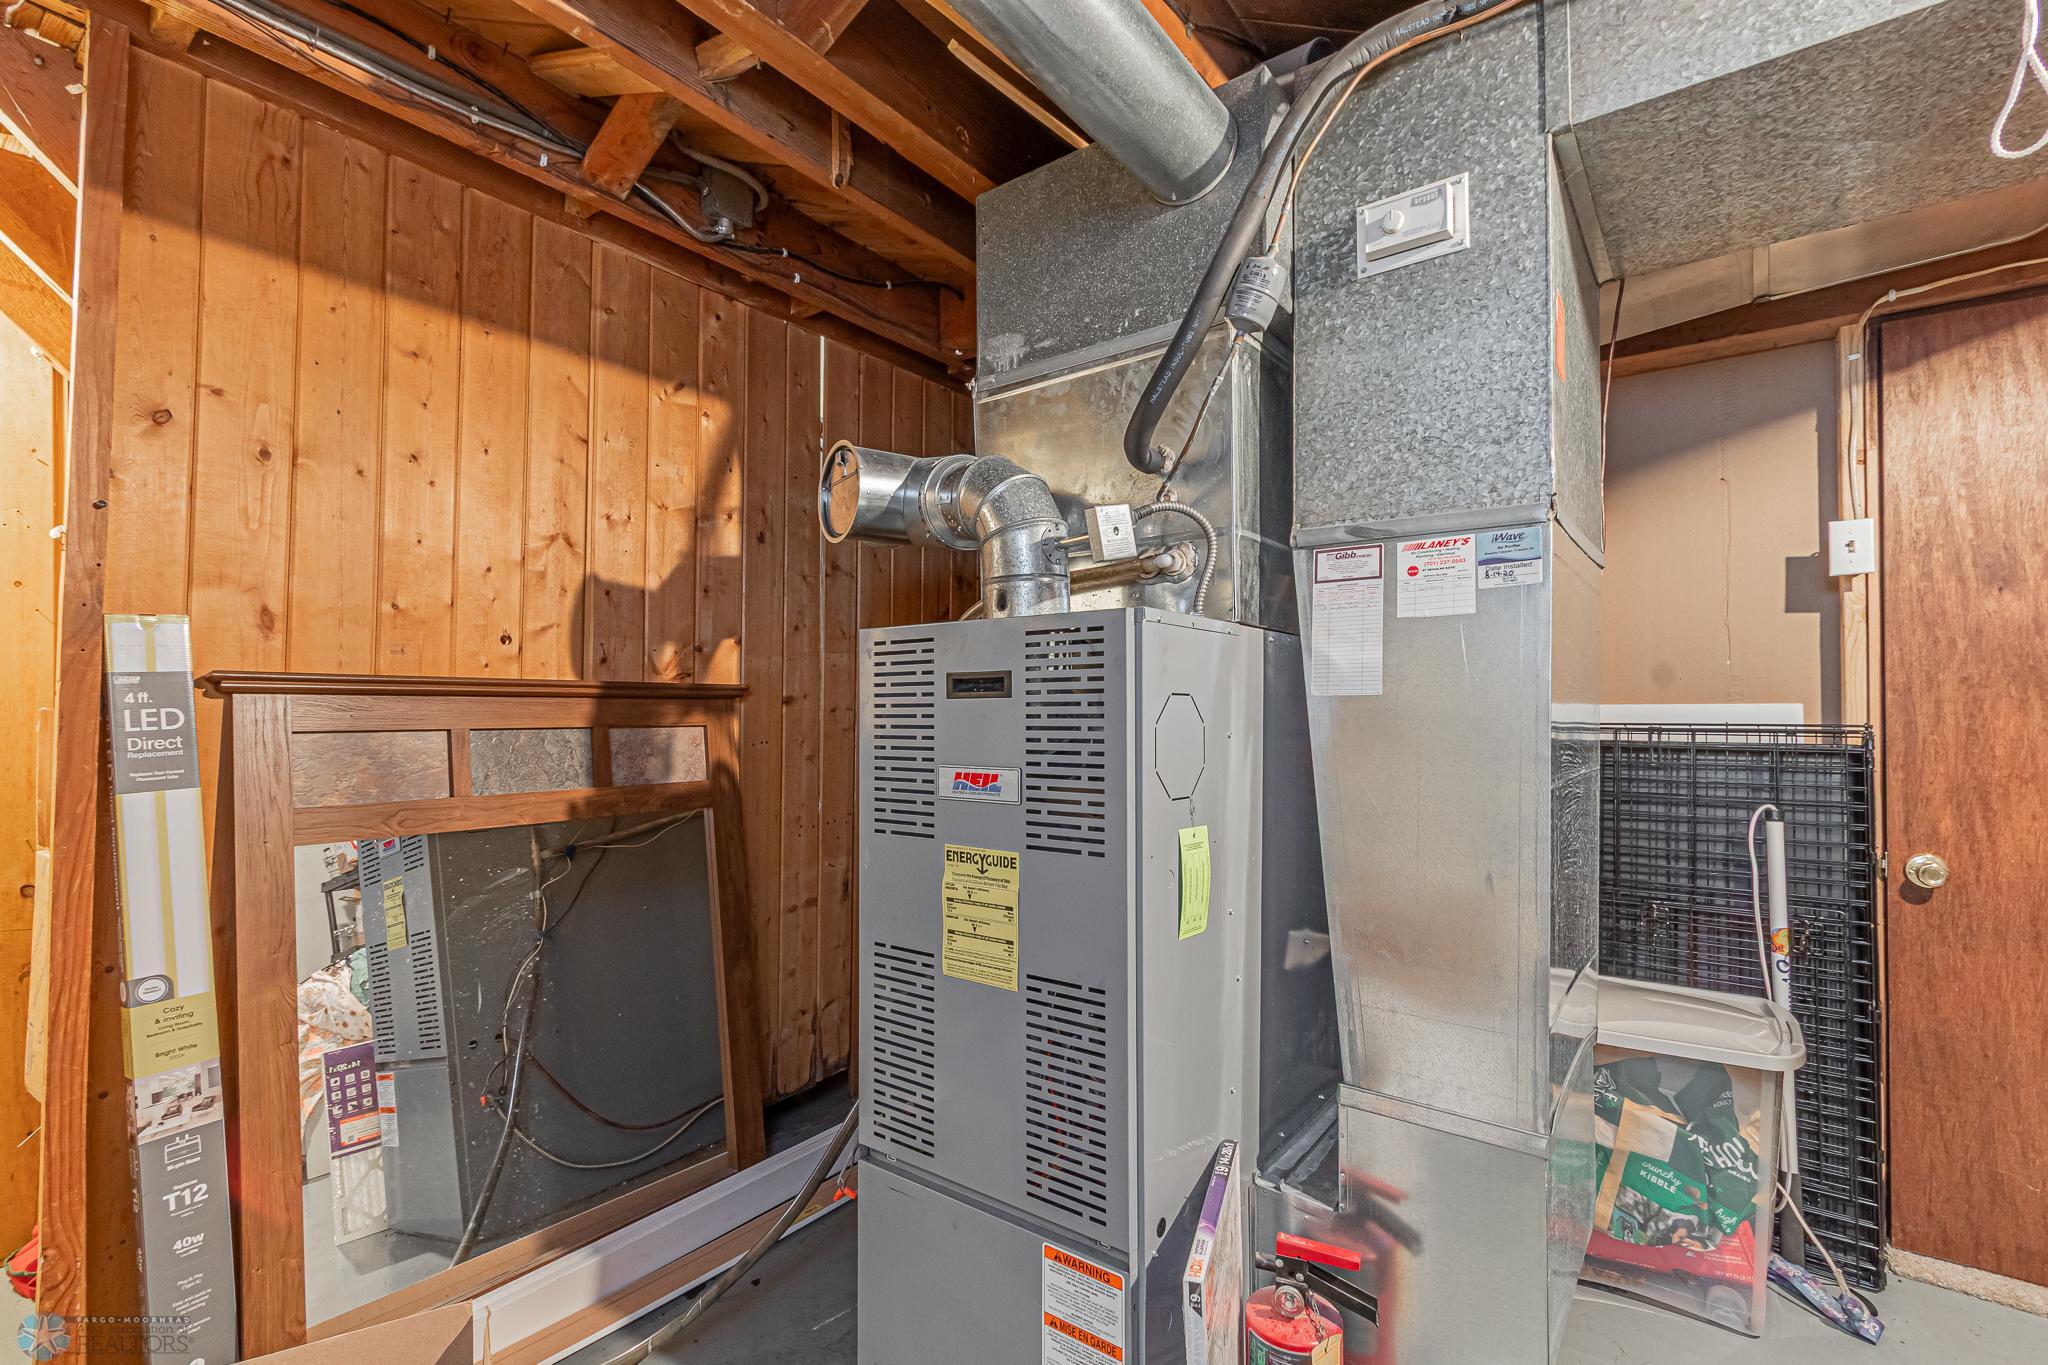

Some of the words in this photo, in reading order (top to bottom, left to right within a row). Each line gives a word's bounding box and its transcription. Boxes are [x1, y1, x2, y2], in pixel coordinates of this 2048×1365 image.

[1422, 537, 1471, 550] LANEY'S
[1335, 551, 1356, 560] Gibb
[124, 692, 135, 703] 4
[137, 691, 153, 703] ft.
[124, 708, 185, 732] LED
[127, 736, 184, 751] Direct
[127, 750, 184, 760] Replacement
[952, 772, 1002, 792] HEIL
[946, 850, 1017, 869] ENERGYGUIDE
[162, 1004, 184, 1014] Cozy
[1640, 1170, 1677, 1194] KIBBLE
[162, 1183, 209, 1211] T12
[1716, 1208, 1737, 1225] high
[1063, 1254, 1110, 1283] WARNING
[1060, 1321, 1077, 1338] MISE
[1079, 1330, 1089, 1344] EN
[1090, 1336, 1117, 1357] GARDE
